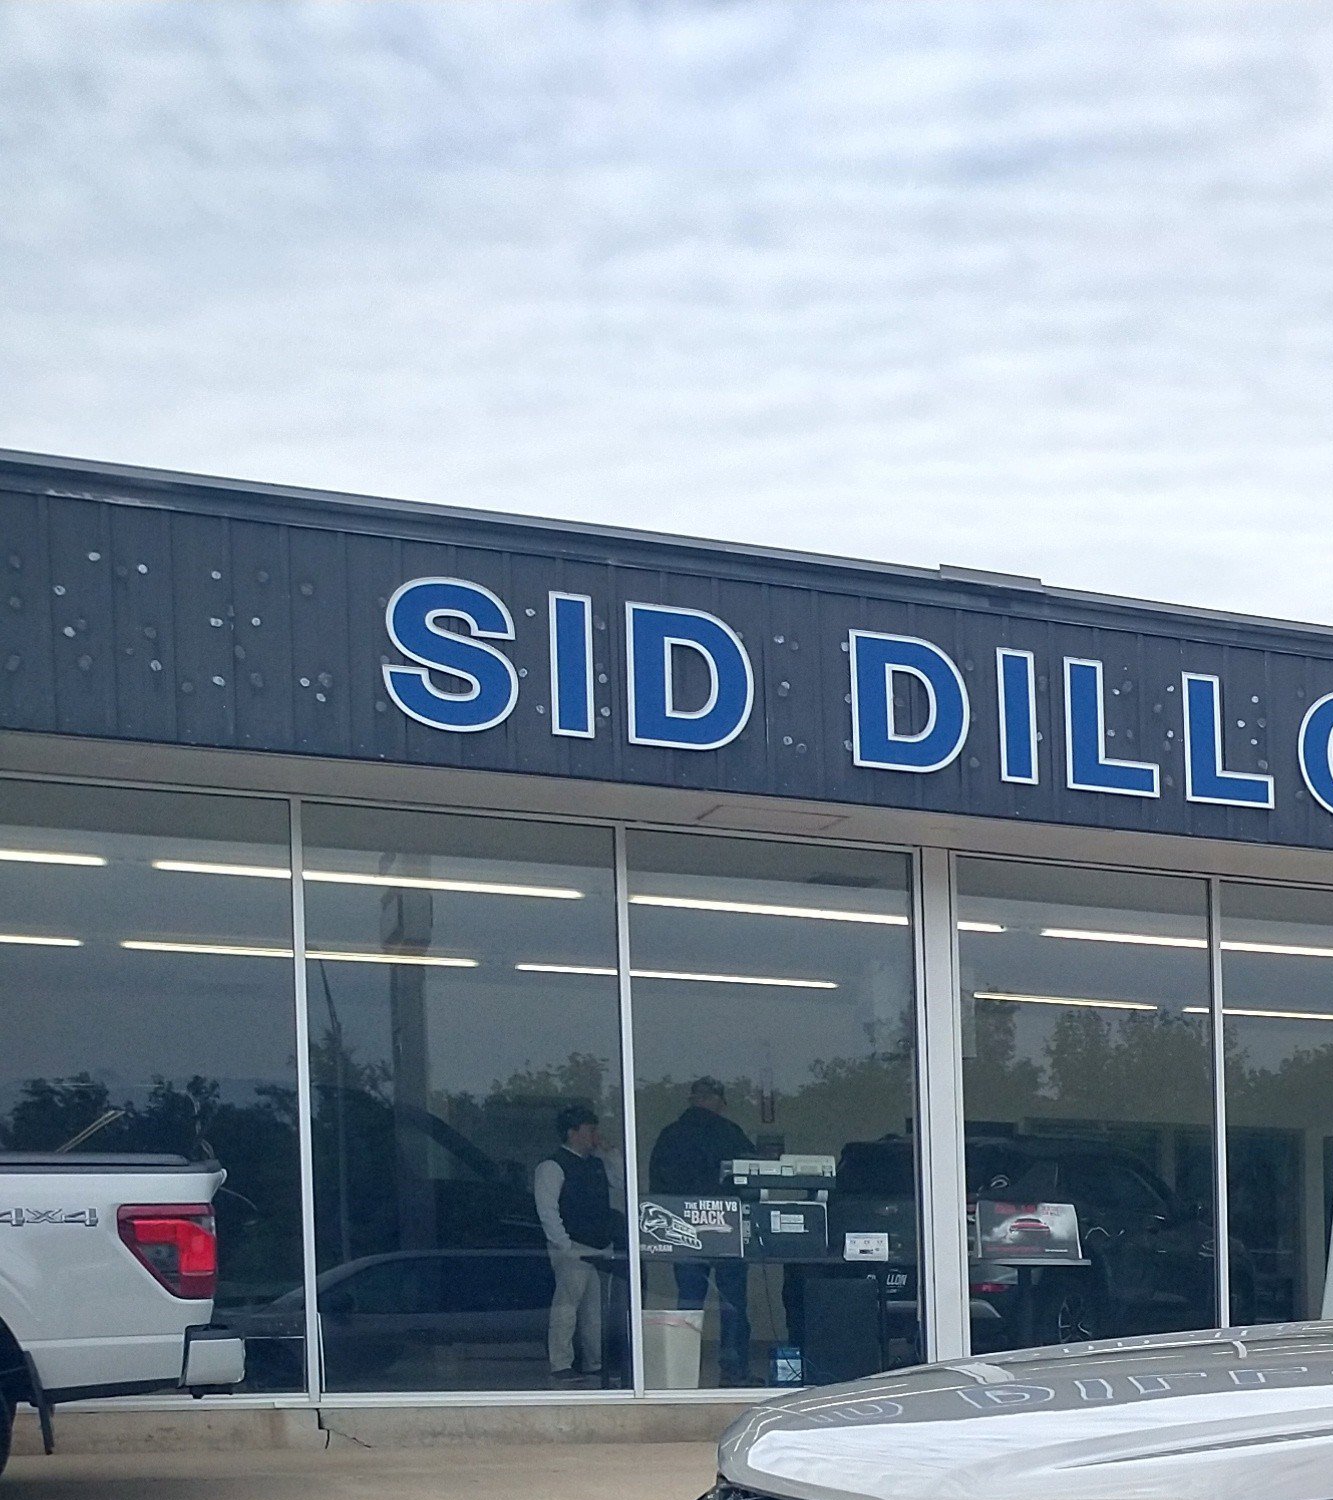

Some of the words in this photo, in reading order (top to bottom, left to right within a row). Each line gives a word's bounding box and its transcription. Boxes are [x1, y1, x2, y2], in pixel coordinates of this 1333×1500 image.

[380, 575, 756, 753] SID
[684, 1201, 698, 1210] THE
[699, 1200, 723, 1211] HEMI
[725, 1201, 738, 1212] V8
[691, 1210, 726, 1225] BACK
